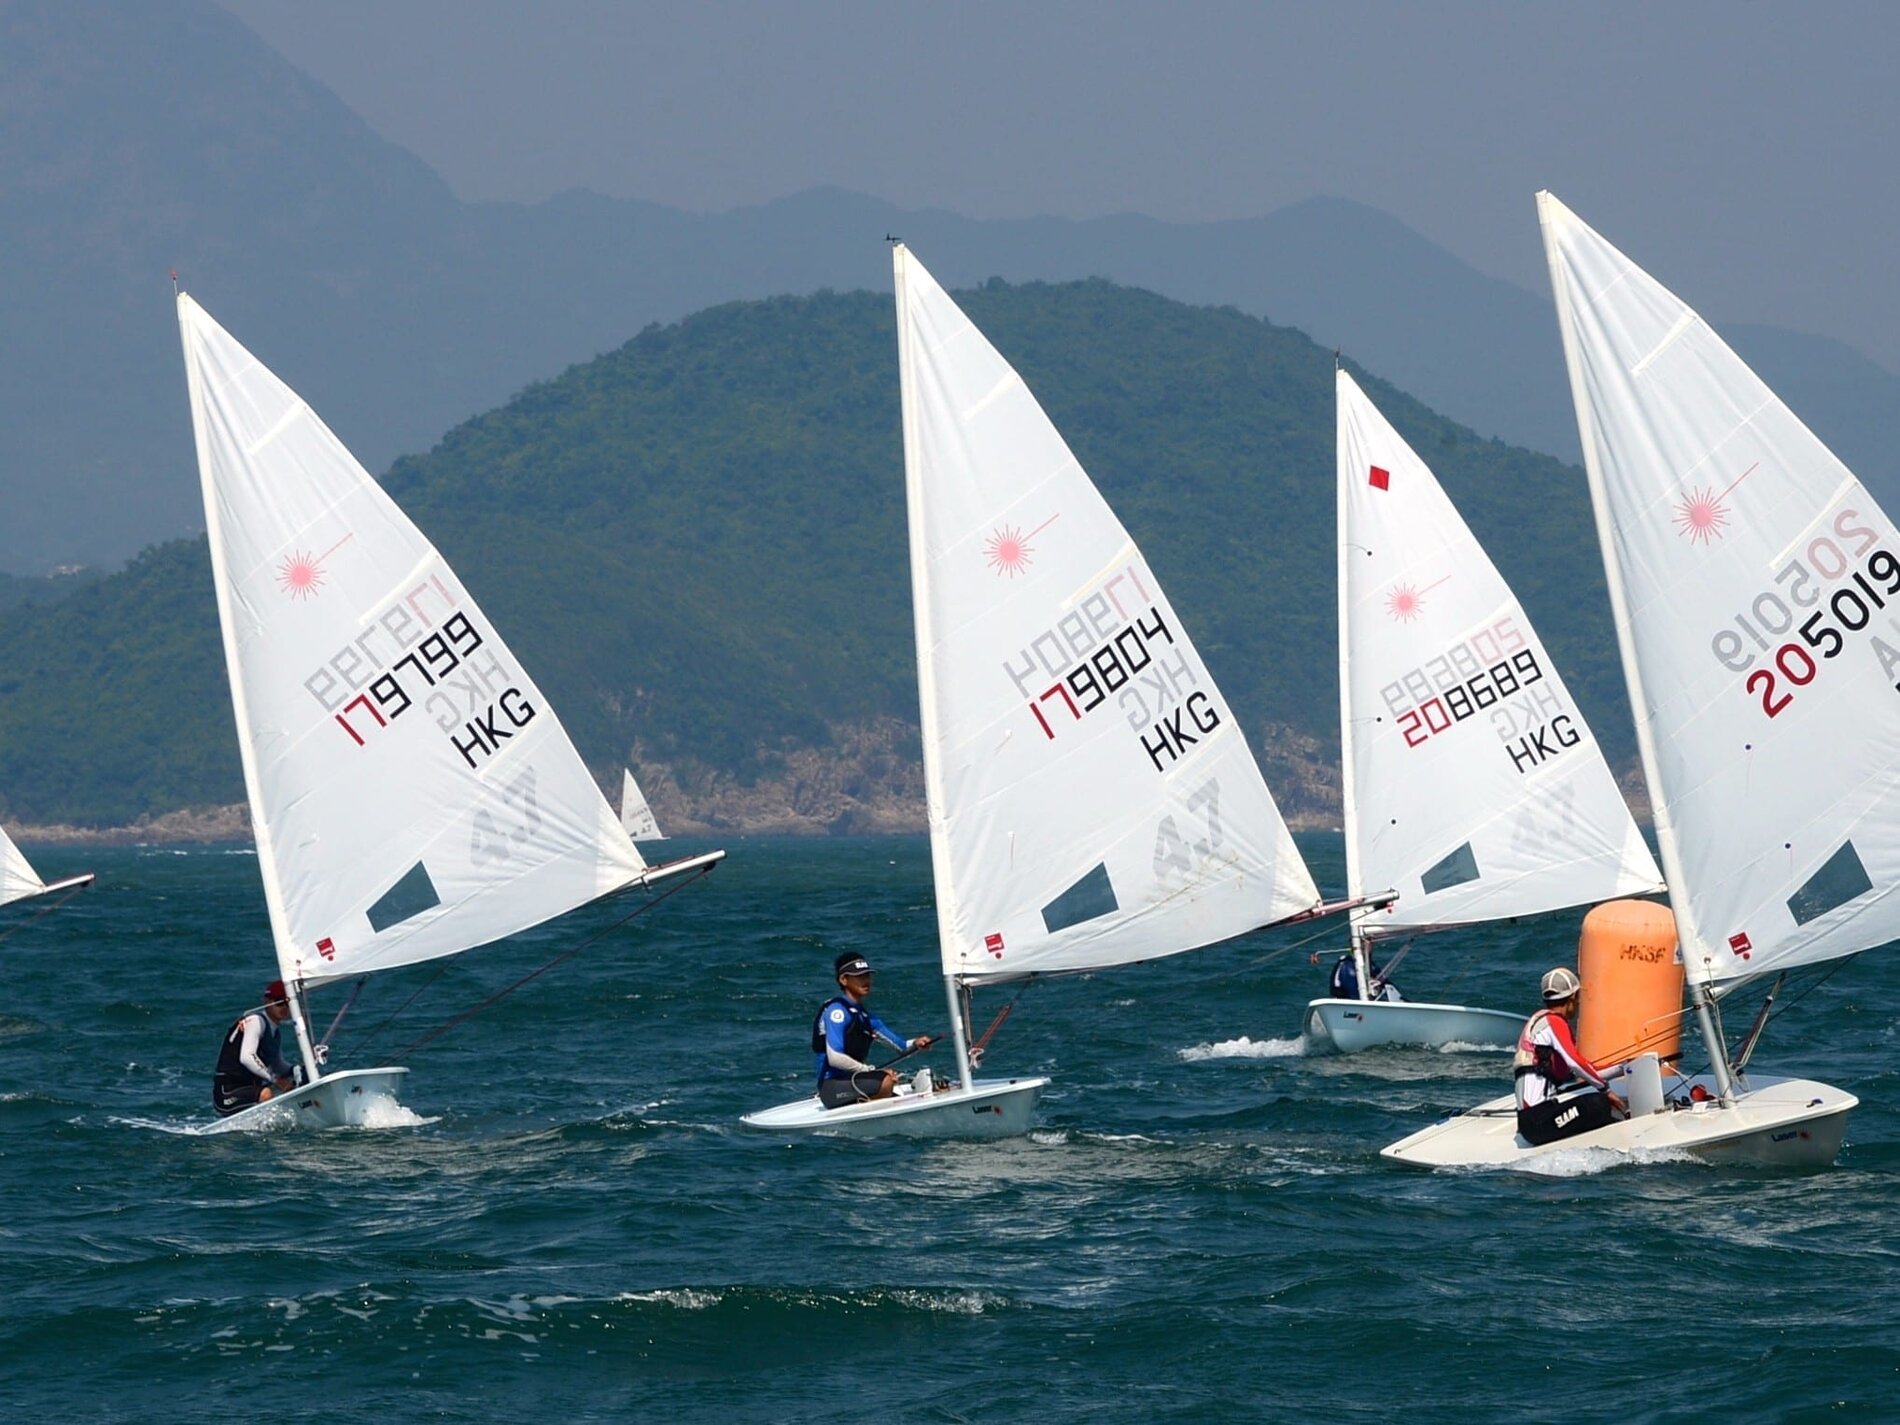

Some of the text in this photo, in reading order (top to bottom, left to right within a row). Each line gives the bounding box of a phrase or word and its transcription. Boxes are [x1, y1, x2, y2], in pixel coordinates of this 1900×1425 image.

[335, 611, 483, 746] 179799
[1029, 606, 1174, 740] 179804
[1746, 550, 1900, 719] 205019
[450, 688, 536, 769] HKG
[1140, 691, 1220, 772] HKG
[1397, 649, 1542, 748] 208689
[1506, 715, 1580, 773] HKG
[1554, 1106, 1579, 1128] SLAM
